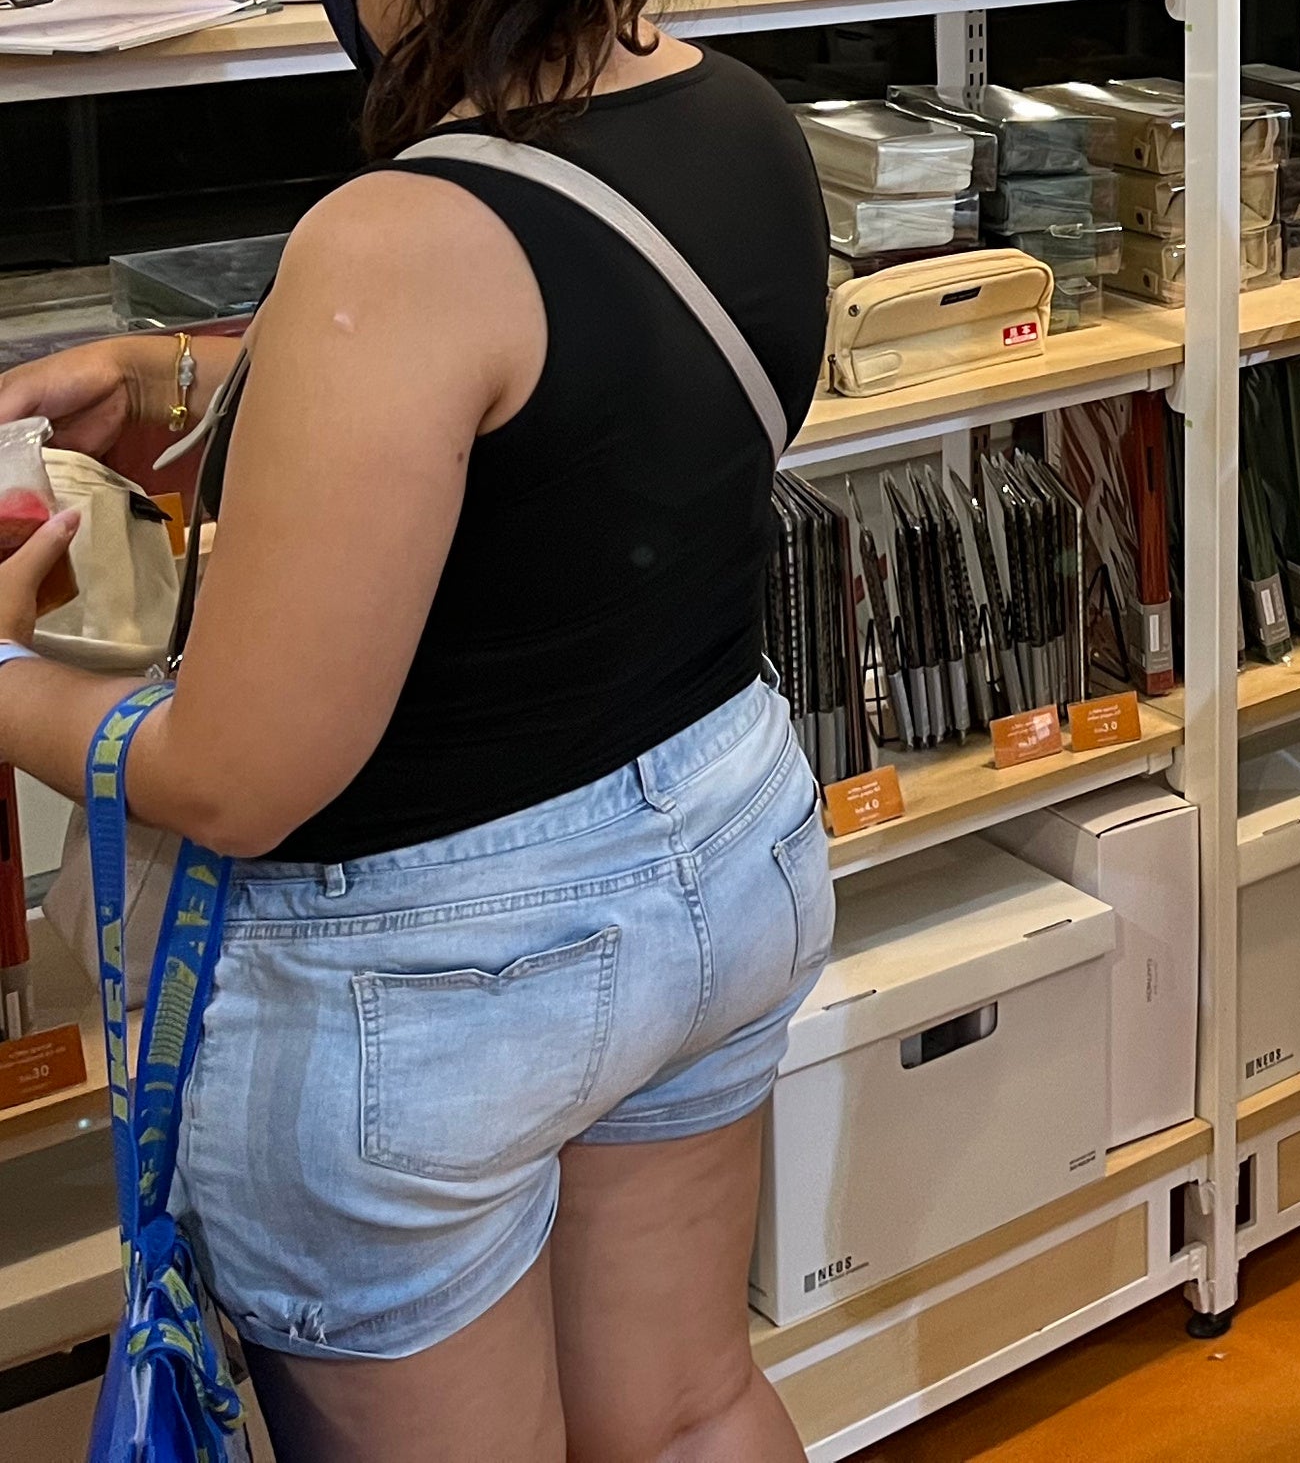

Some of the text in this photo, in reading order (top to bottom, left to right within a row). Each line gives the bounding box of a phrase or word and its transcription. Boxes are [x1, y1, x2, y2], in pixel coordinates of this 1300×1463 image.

[92, 683, 176, 799] IKE
[1256, 1048, 1282, 1070] NEOS
[817, 1255, 852, 1282] NEOS
